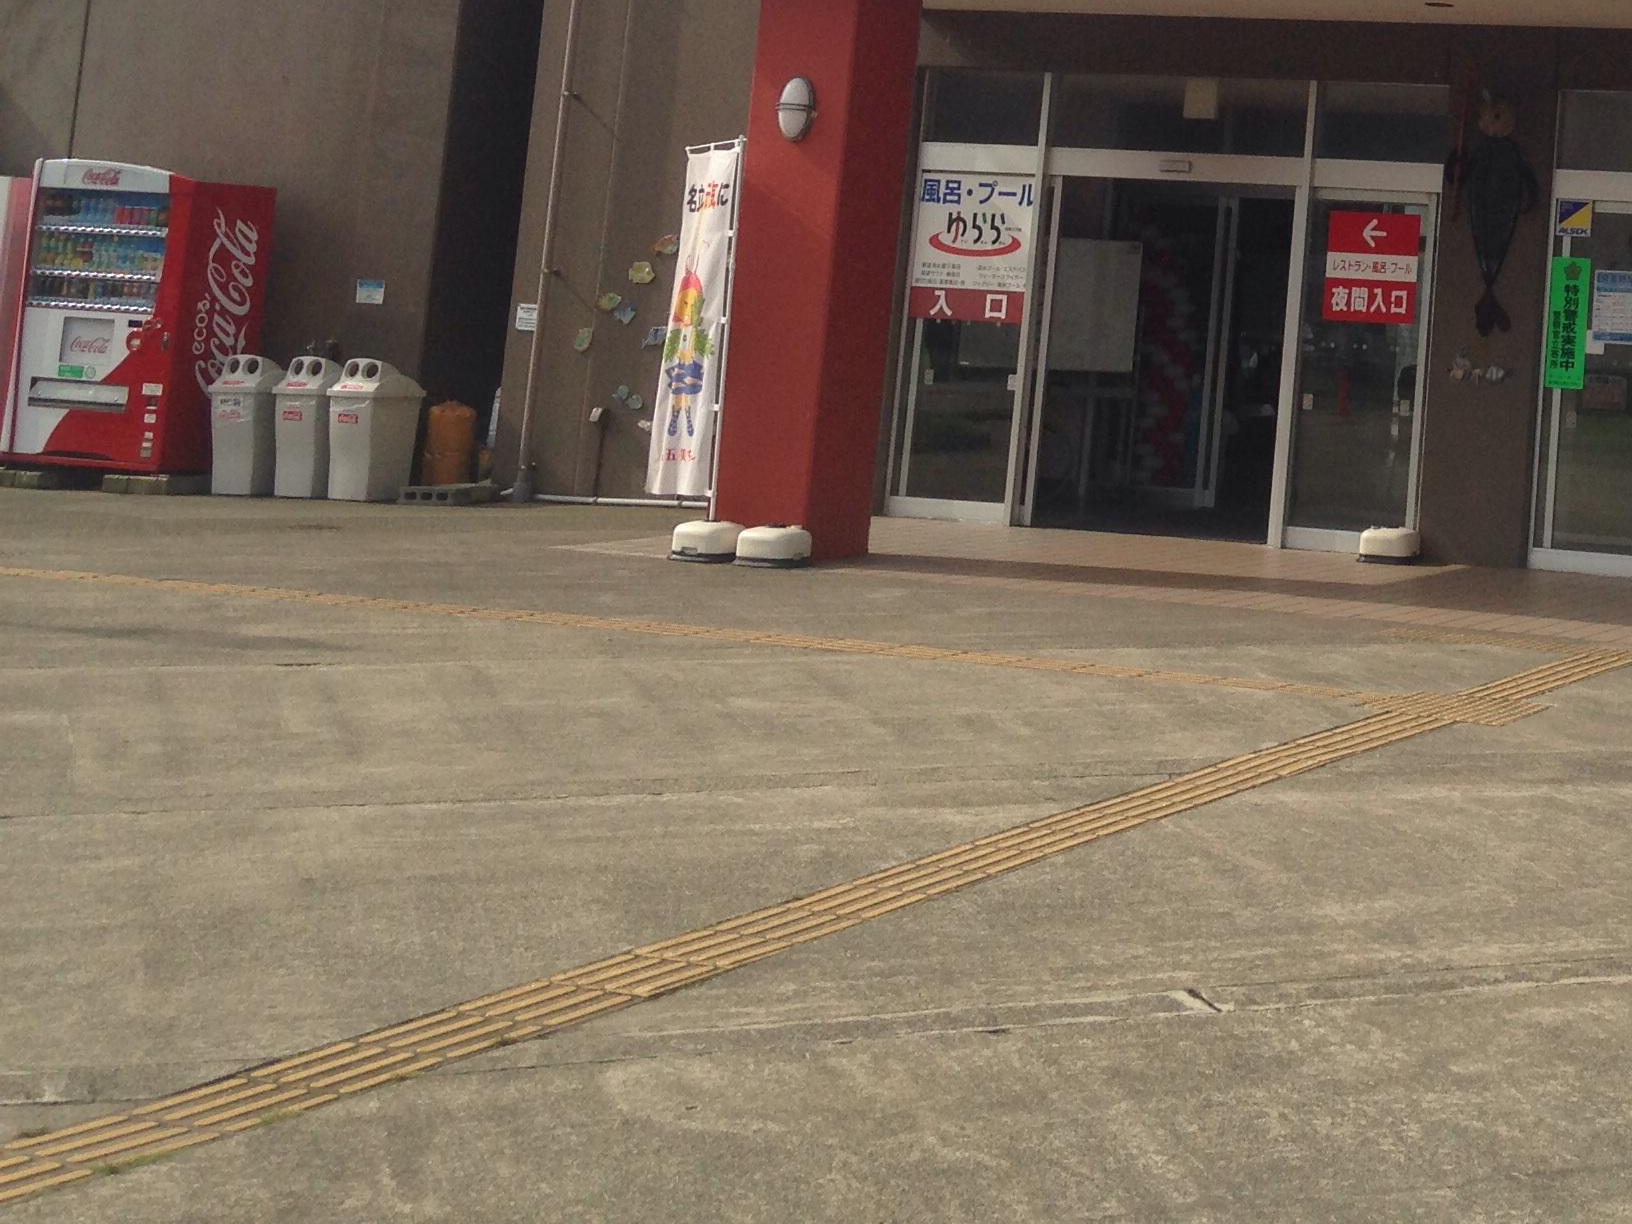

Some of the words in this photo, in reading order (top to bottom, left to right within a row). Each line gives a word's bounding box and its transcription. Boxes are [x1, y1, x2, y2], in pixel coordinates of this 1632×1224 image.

[921, 179, 1034, 207] 風呂・プール
[946, 210, 1006, 245] ゆらら
[929, 289, 1009, 320] 入口
[1331, 286, 1409, 315] 夜間入口
